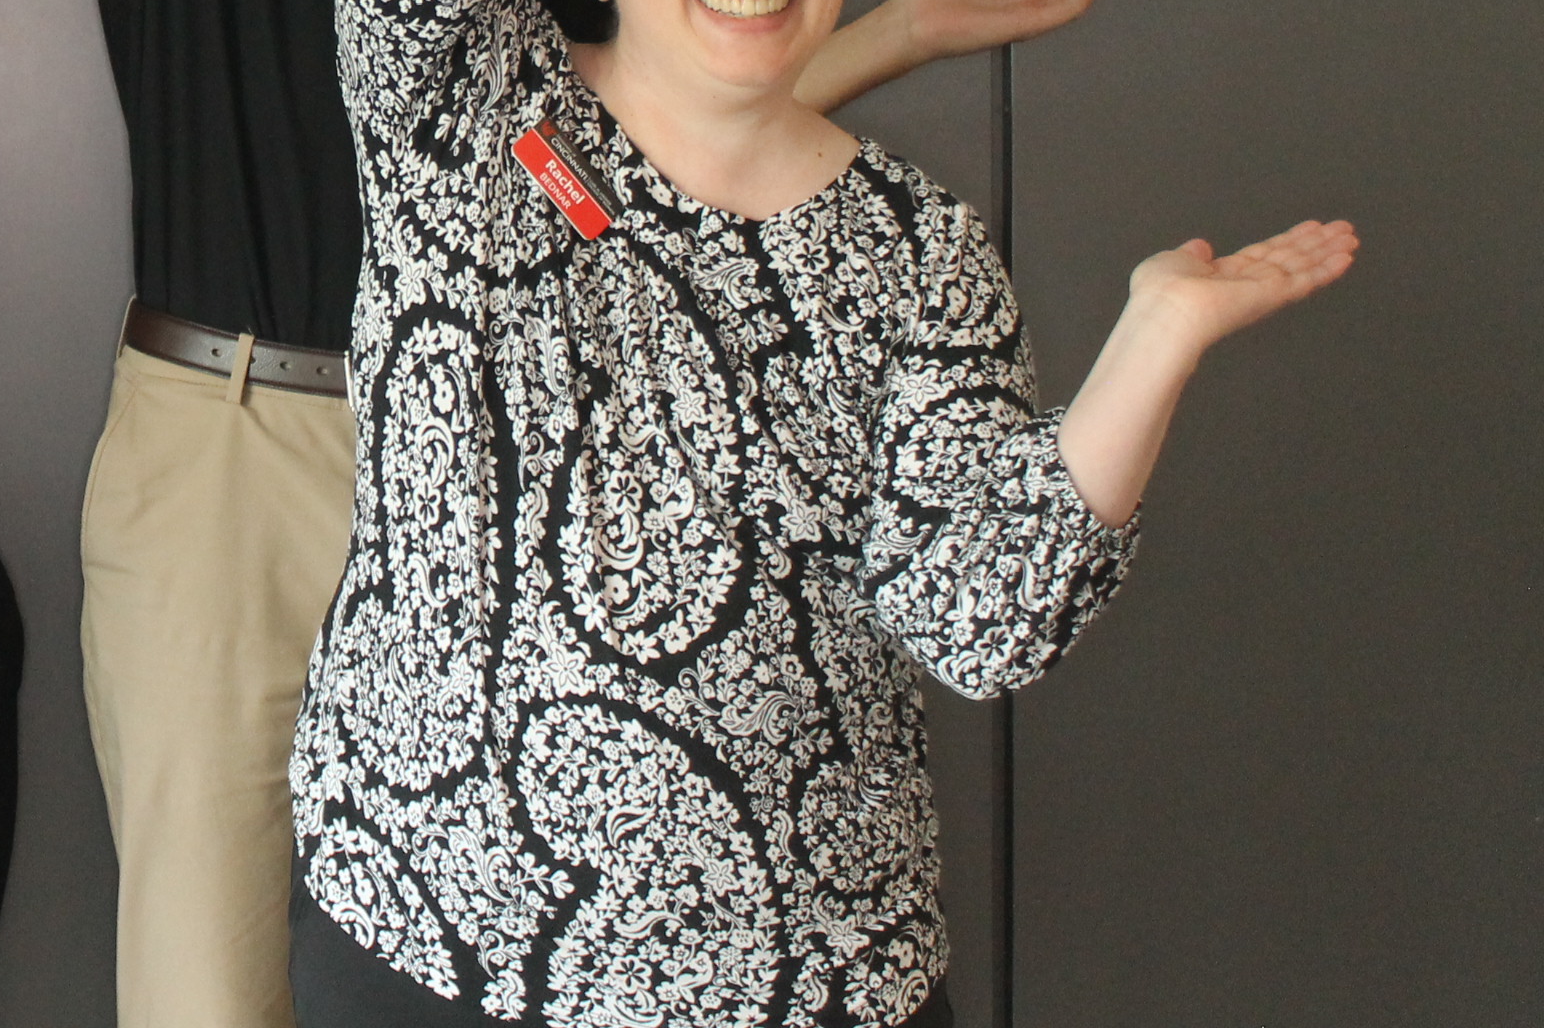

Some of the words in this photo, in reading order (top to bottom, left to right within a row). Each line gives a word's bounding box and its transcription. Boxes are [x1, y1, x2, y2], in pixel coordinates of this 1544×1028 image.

[551, 137, 589, 181] CINCINNATI
[539, 172, 572, 210] BEDNAR
[545, 159, 586, 205] Rachel
